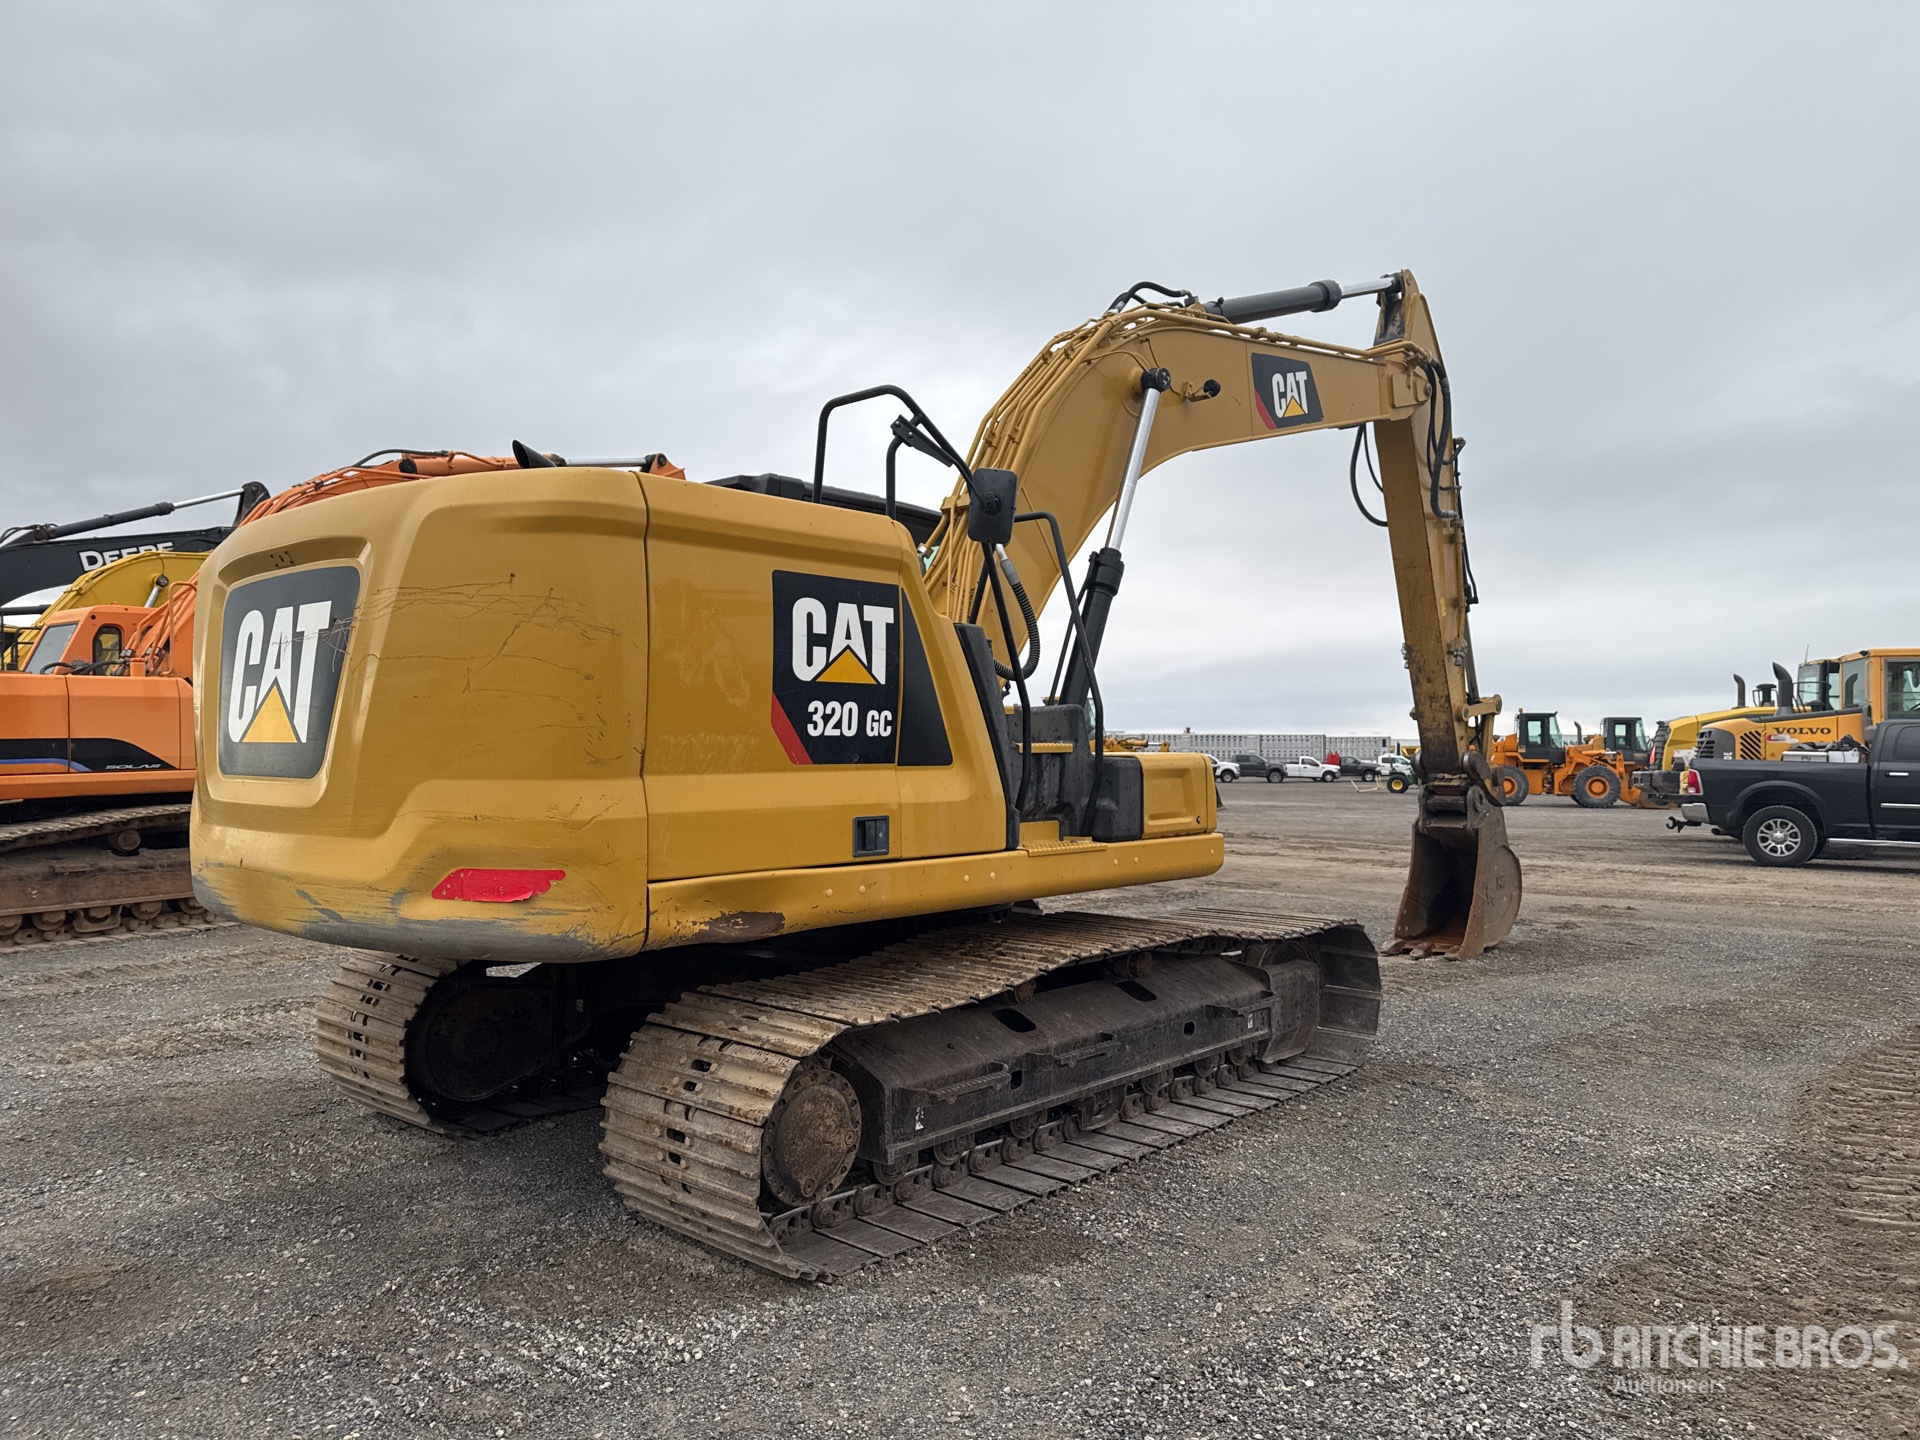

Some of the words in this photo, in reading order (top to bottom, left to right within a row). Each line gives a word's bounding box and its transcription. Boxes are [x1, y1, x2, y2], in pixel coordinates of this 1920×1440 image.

[1272, 371, 1308, 418] CAT
[792, 597, 895, 685] CAT
[228, 600, 333, 744] CAT
[807, 700, 859, 737] 320
[866, 710, 892, 737] GC
[1773, 727, 1832, 735] VOLVO
